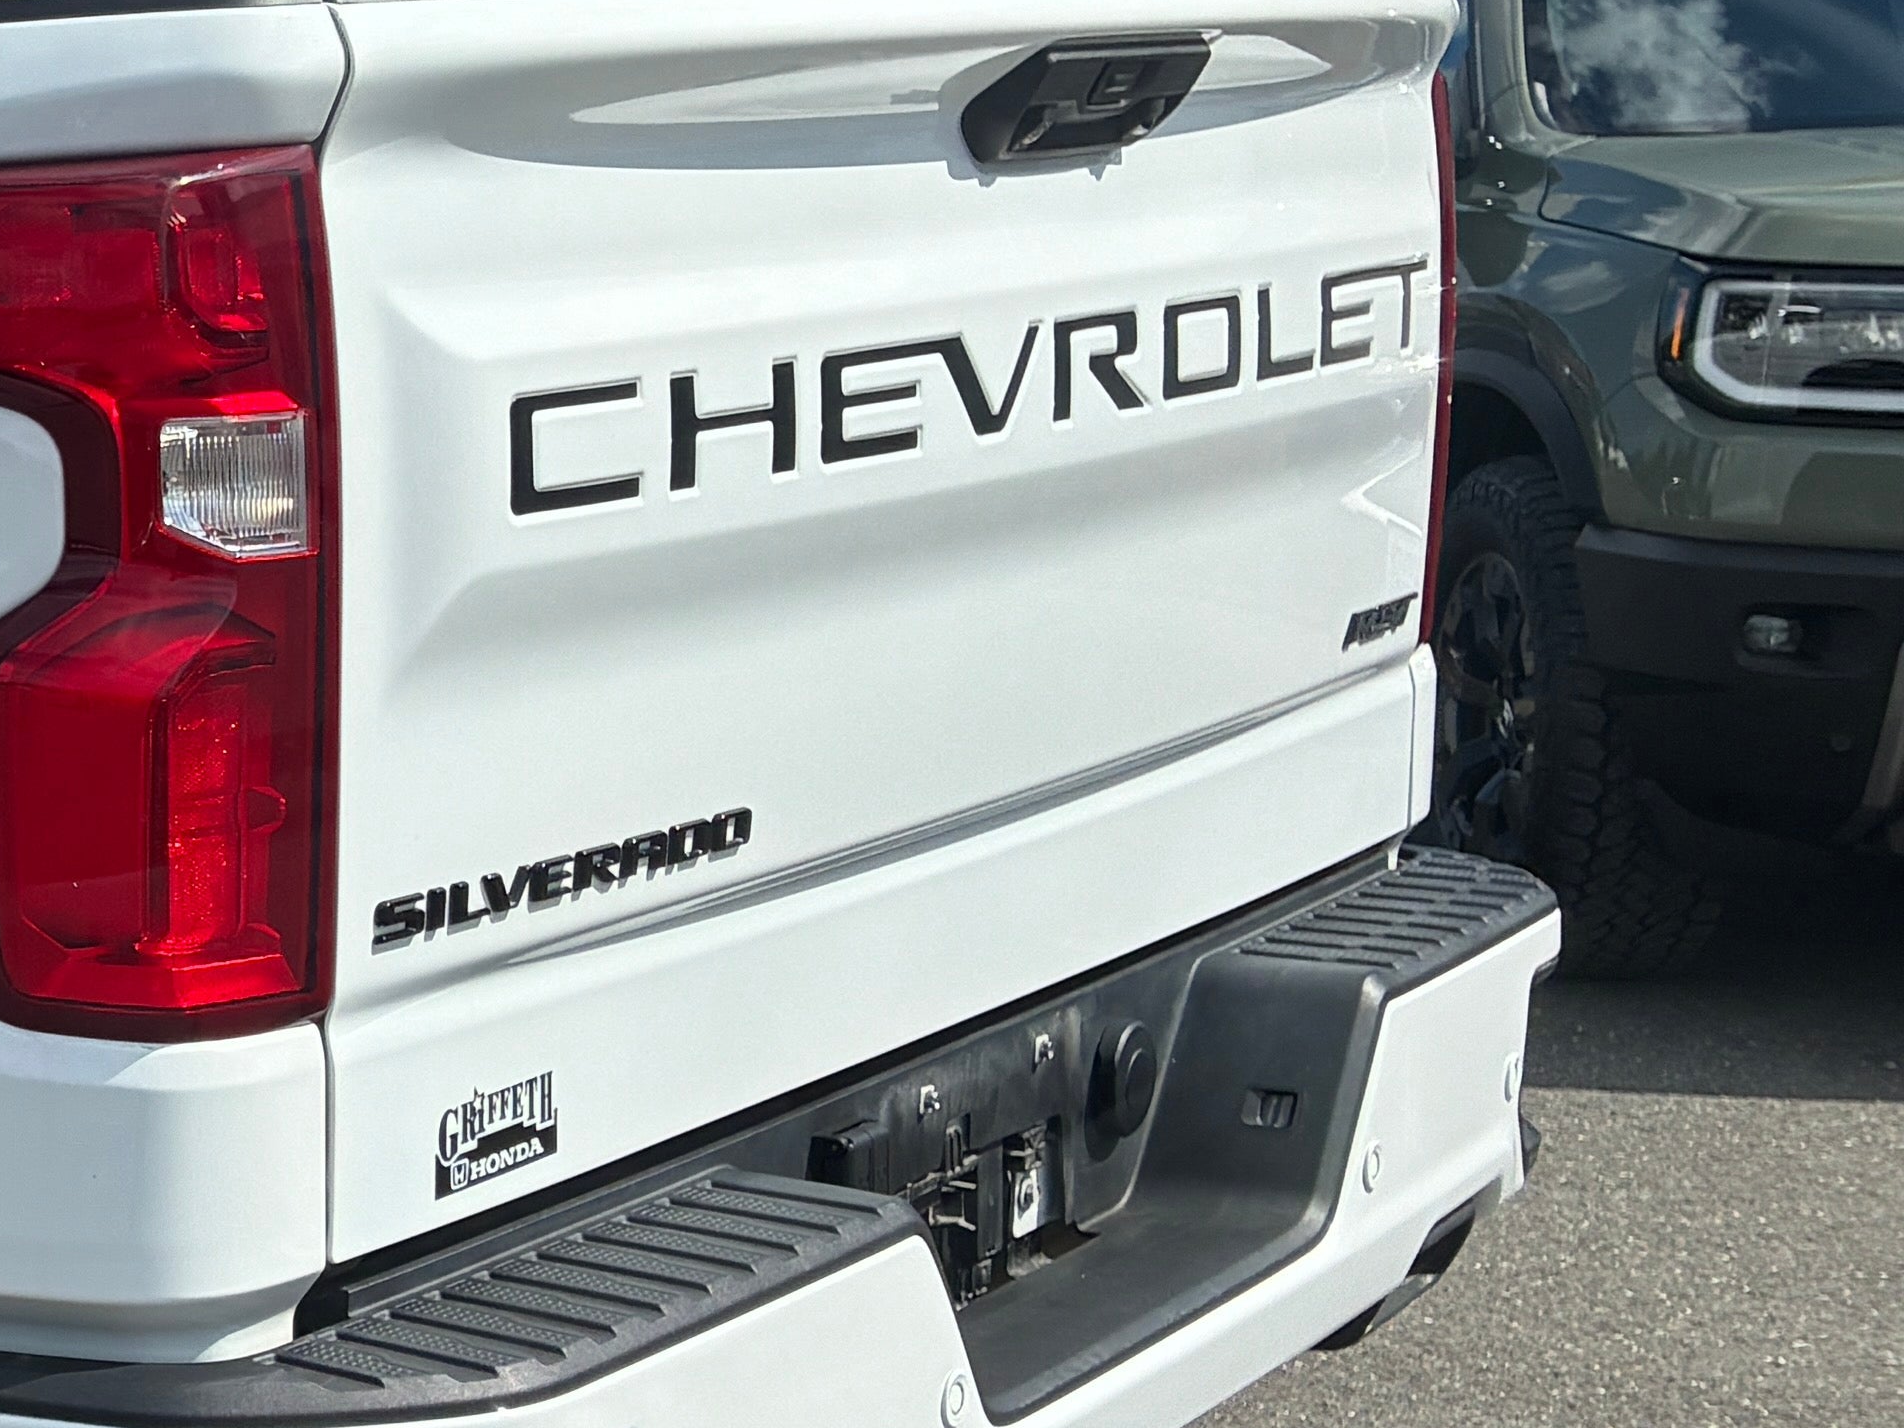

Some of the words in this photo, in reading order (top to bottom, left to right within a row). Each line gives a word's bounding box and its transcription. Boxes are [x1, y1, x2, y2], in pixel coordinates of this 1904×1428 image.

[510, 256, 1430, 515] CHEVROLET
[373, 808, 753, 945] SILVERADO
[438, 1070, 554, 1163] GRIFFETH
[469, 1136, 545, 1181] HONDA
